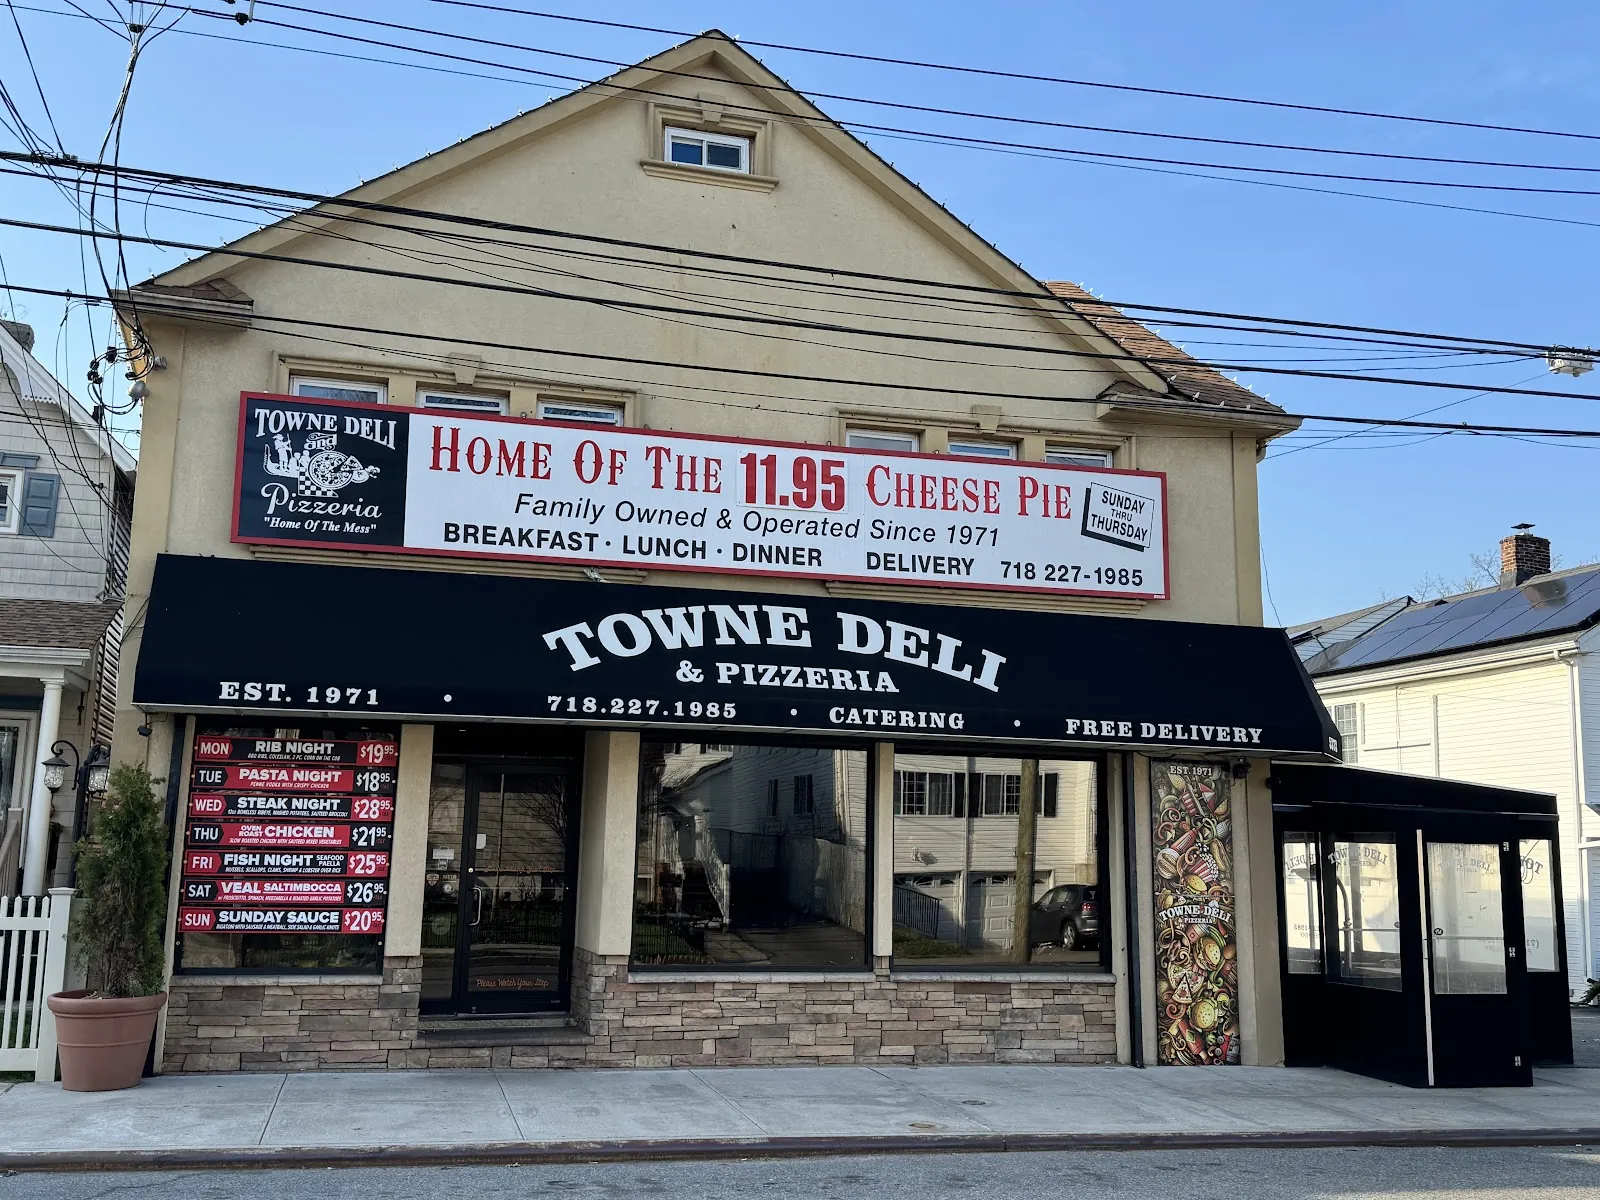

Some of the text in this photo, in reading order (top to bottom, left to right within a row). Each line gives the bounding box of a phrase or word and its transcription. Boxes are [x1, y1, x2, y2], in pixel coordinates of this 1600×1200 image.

[255, 409, 397, 450] TOWNE DELI
[304, 432, 337, 451] and
[429, 426, 1071, 519] HOME OF THE 11.95 CHEESE PIE
[261, 483, 382, 519] Pizzeria
[1102, 490, 1145, 514] SUNDAY
[514, 493, 998, 547] Family Owned & Operated Since 1971
[1111, 509, 1132, 521] THRU
[305, 520, 319, 532] Of
[322, 521, 340, 532] The
[1091, 514, 1148, 542] THURSDAY
[444, 523, 1143, 586] BREAKFAST LUNCH DINNER DELIVERY 718 227-1985
[542, 605, 1007, 692] TOWNE DELI
[676, 660, 899, 692] & PIZZERIA
[219, 682, 378, 705] EST. 1971
[548, 696, 736, 718] 718.227.1985
[829, 707, 964, 729] CATERING
[1066, 719, 1263, 743] FREE DELIVERY
[201, 742, 229, 754] MON
[256, 741, 334, 754] RIB NIGHT
[199, 770, 222, 783] TUE
[239, 769, 341, 782] PASTA NIGHT
[1170, 766, 1212, 775] EST. 1971
[196, 799, 222, 811] WED
[237, 797, 340, 810] STEAK NIGHT
[194, 827, 218, 840] THU
[265, 826, 334, 838] CHICKEN
[193, 857, 212, 868] FRI
[224, 854, 313, 866] FISH NIGHT
[1364, 847, 1388, 865] DELI
[188, 885, 211, 897] SAT
[221, 882, 342, 893] VEAL SALTIMBOCCA
[185, 913, 210, 926] SUN
[218, 911, 339, 923] SUNDAY SAUCE
[1159, 905, 1231, 922] TOWNE DELI
[476, 978, 496, 987] Please
